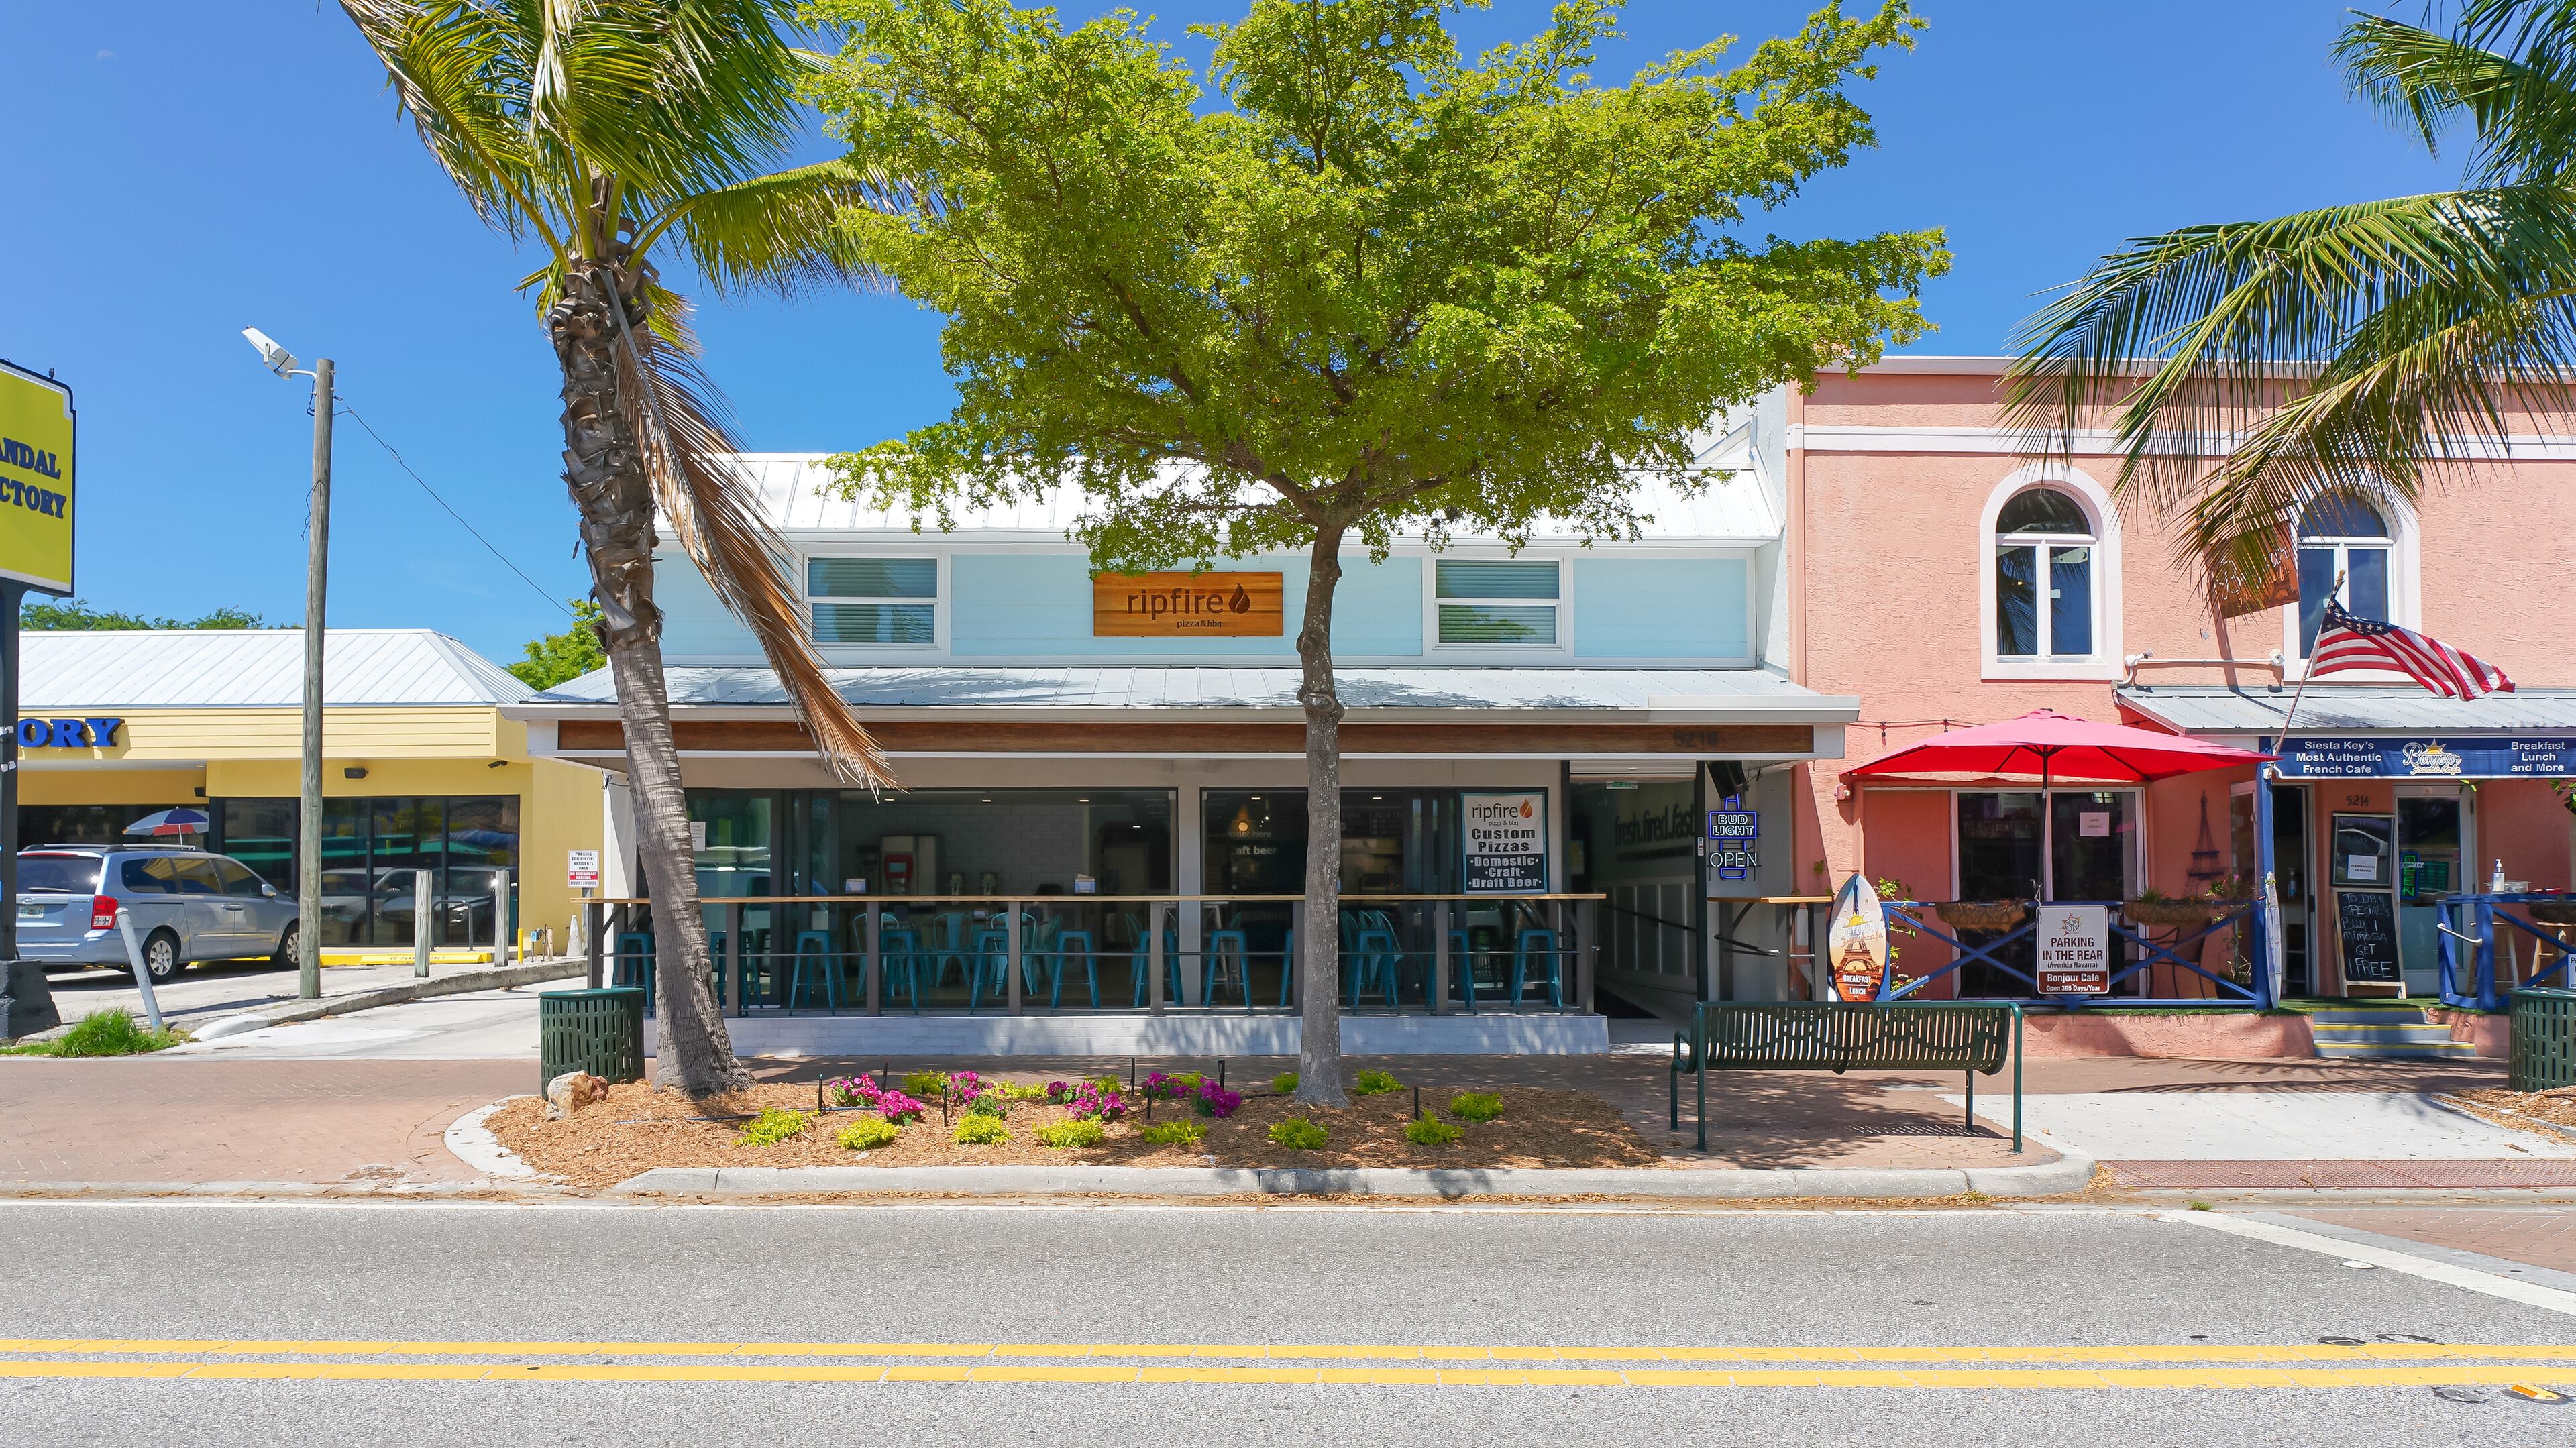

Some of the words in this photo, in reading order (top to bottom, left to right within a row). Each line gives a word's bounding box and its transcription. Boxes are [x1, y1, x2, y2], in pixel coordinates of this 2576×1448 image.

[1127, 588, 1224, 620] ripfire
[1208, 620, 1222, 628] bbq
[18, 718, 125, 747] ORY
[2304, 741, 2340, 750] Siesta
[2511, 741, 2565, 750] Breakfast
[2296, 753, 2324, 762] Most
[2326, 753, 2382, 762] Authentic
[2402, 742, 2461, 766] Bonjour
[2522, 752, 2556, 761] Lunch
[2302, 765, 2342, 773] French
[2345, 765, 2372, 773] Cafe
[2511, 763, 2532, 772] and
[2536, 763, 2565, 772] More
[2346, 795, 2369, 806] 5214
[1472, 803, 1519, 822] ripfire
[1717, 814, 1748, 825] BUD
[1471, 828, 1536, 839] Custom
[1712, 825, 1754, 836] LIGHT
[1254, 846, 1277, 854] beer
[1477, 841, 1529, 852] Pizzas
[1474, 856, 1535, 867] Domestic
[1709, 852, 1757, 867] OPEN
[1489, 867, 1521, 877] Craft
[1472, 878, 1504, 887] Draft
[1507, 878, 1538, 887] Beer
[2051, 937, 2094, 948] PARKING
[2043, 950, 2052, 960] IN
[2055, 950, 2074, 960] THE
[2077, 950, 2103, 960] REAR
[2355, 944, 2375, 956] GET
[2355, 957, 2394, 977] FREE
[1843, 974, 1871, 983] BREAKFAST
[2047, 973, 2079, 984] Bonjour
[2081, 973, 2100, 982] Cafe
[1849, 987, 1866, 995] LUNCH
